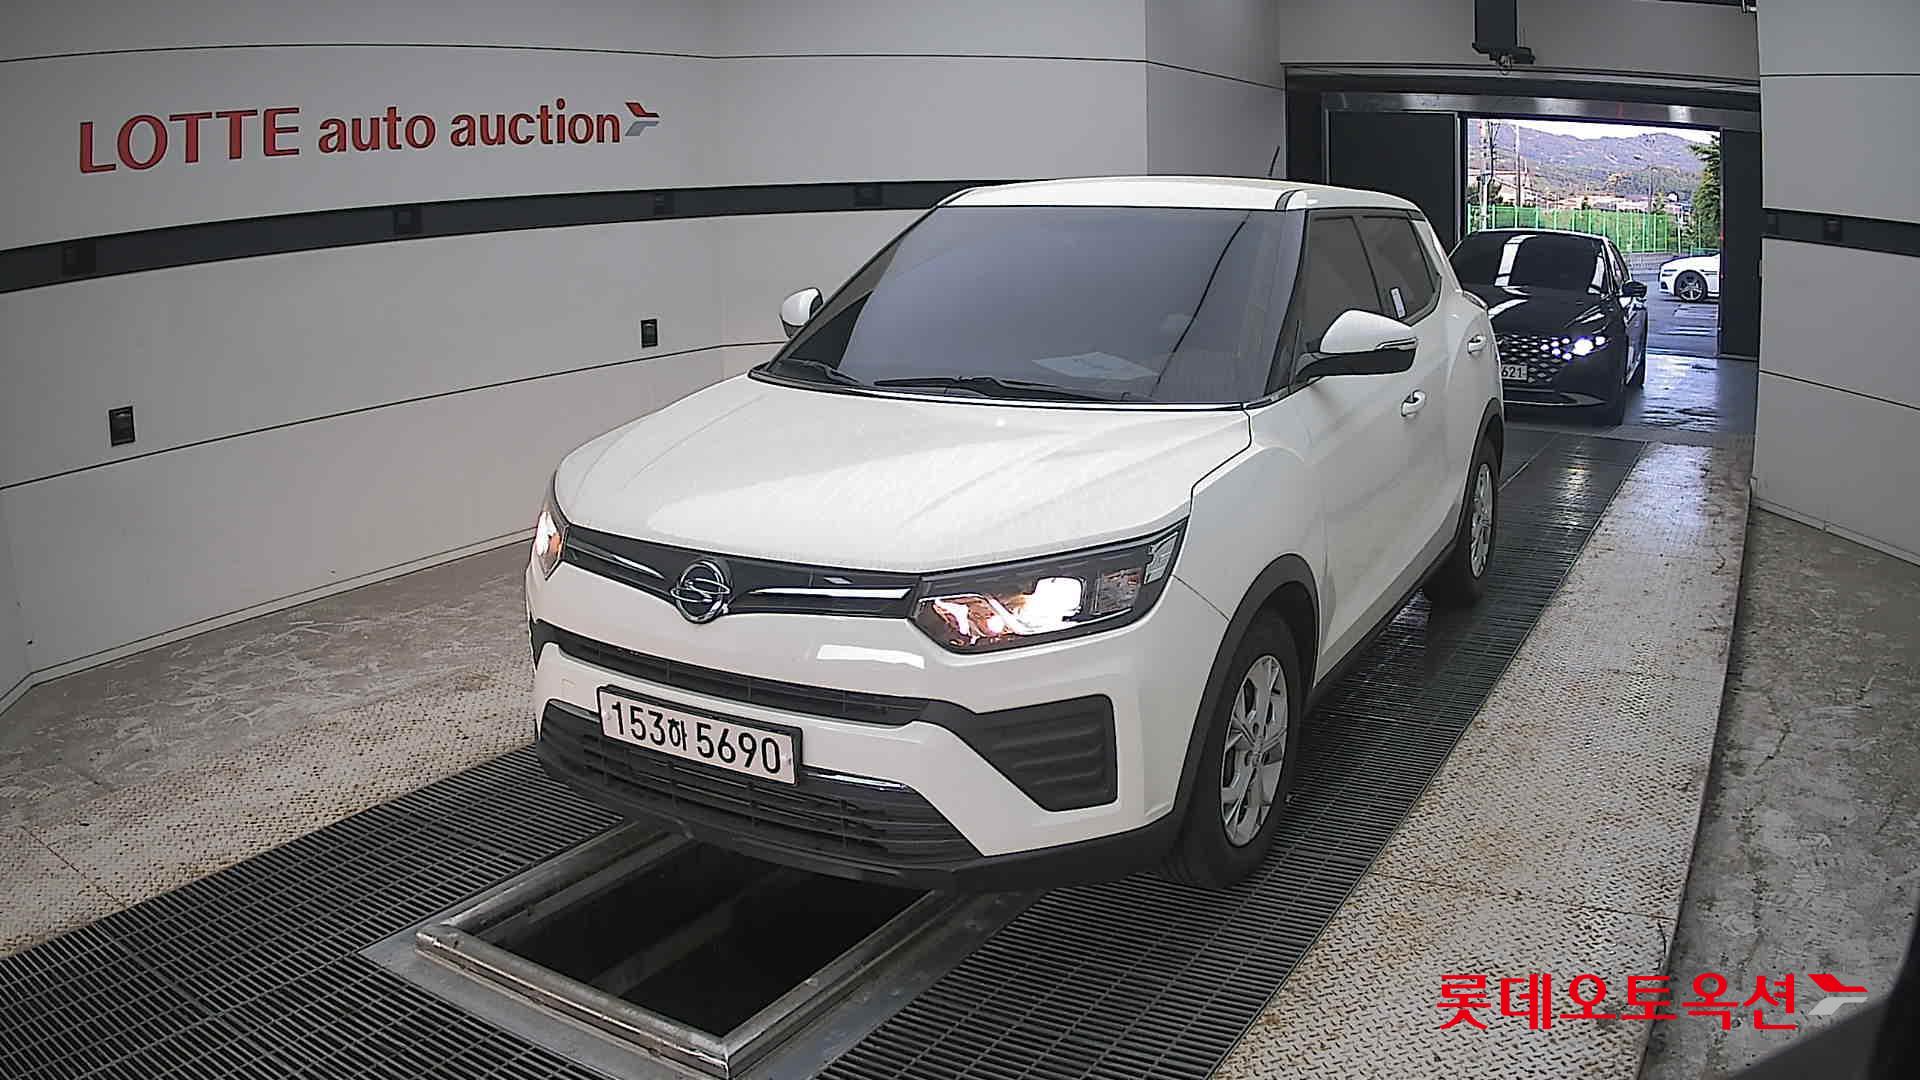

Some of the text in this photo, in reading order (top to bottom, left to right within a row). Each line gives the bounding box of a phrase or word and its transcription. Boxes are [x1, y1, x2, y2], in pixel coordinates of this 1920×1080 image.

[80, 98, 621, 173] LOTTE auto auction
[696, 722, 781, 774] 5690
